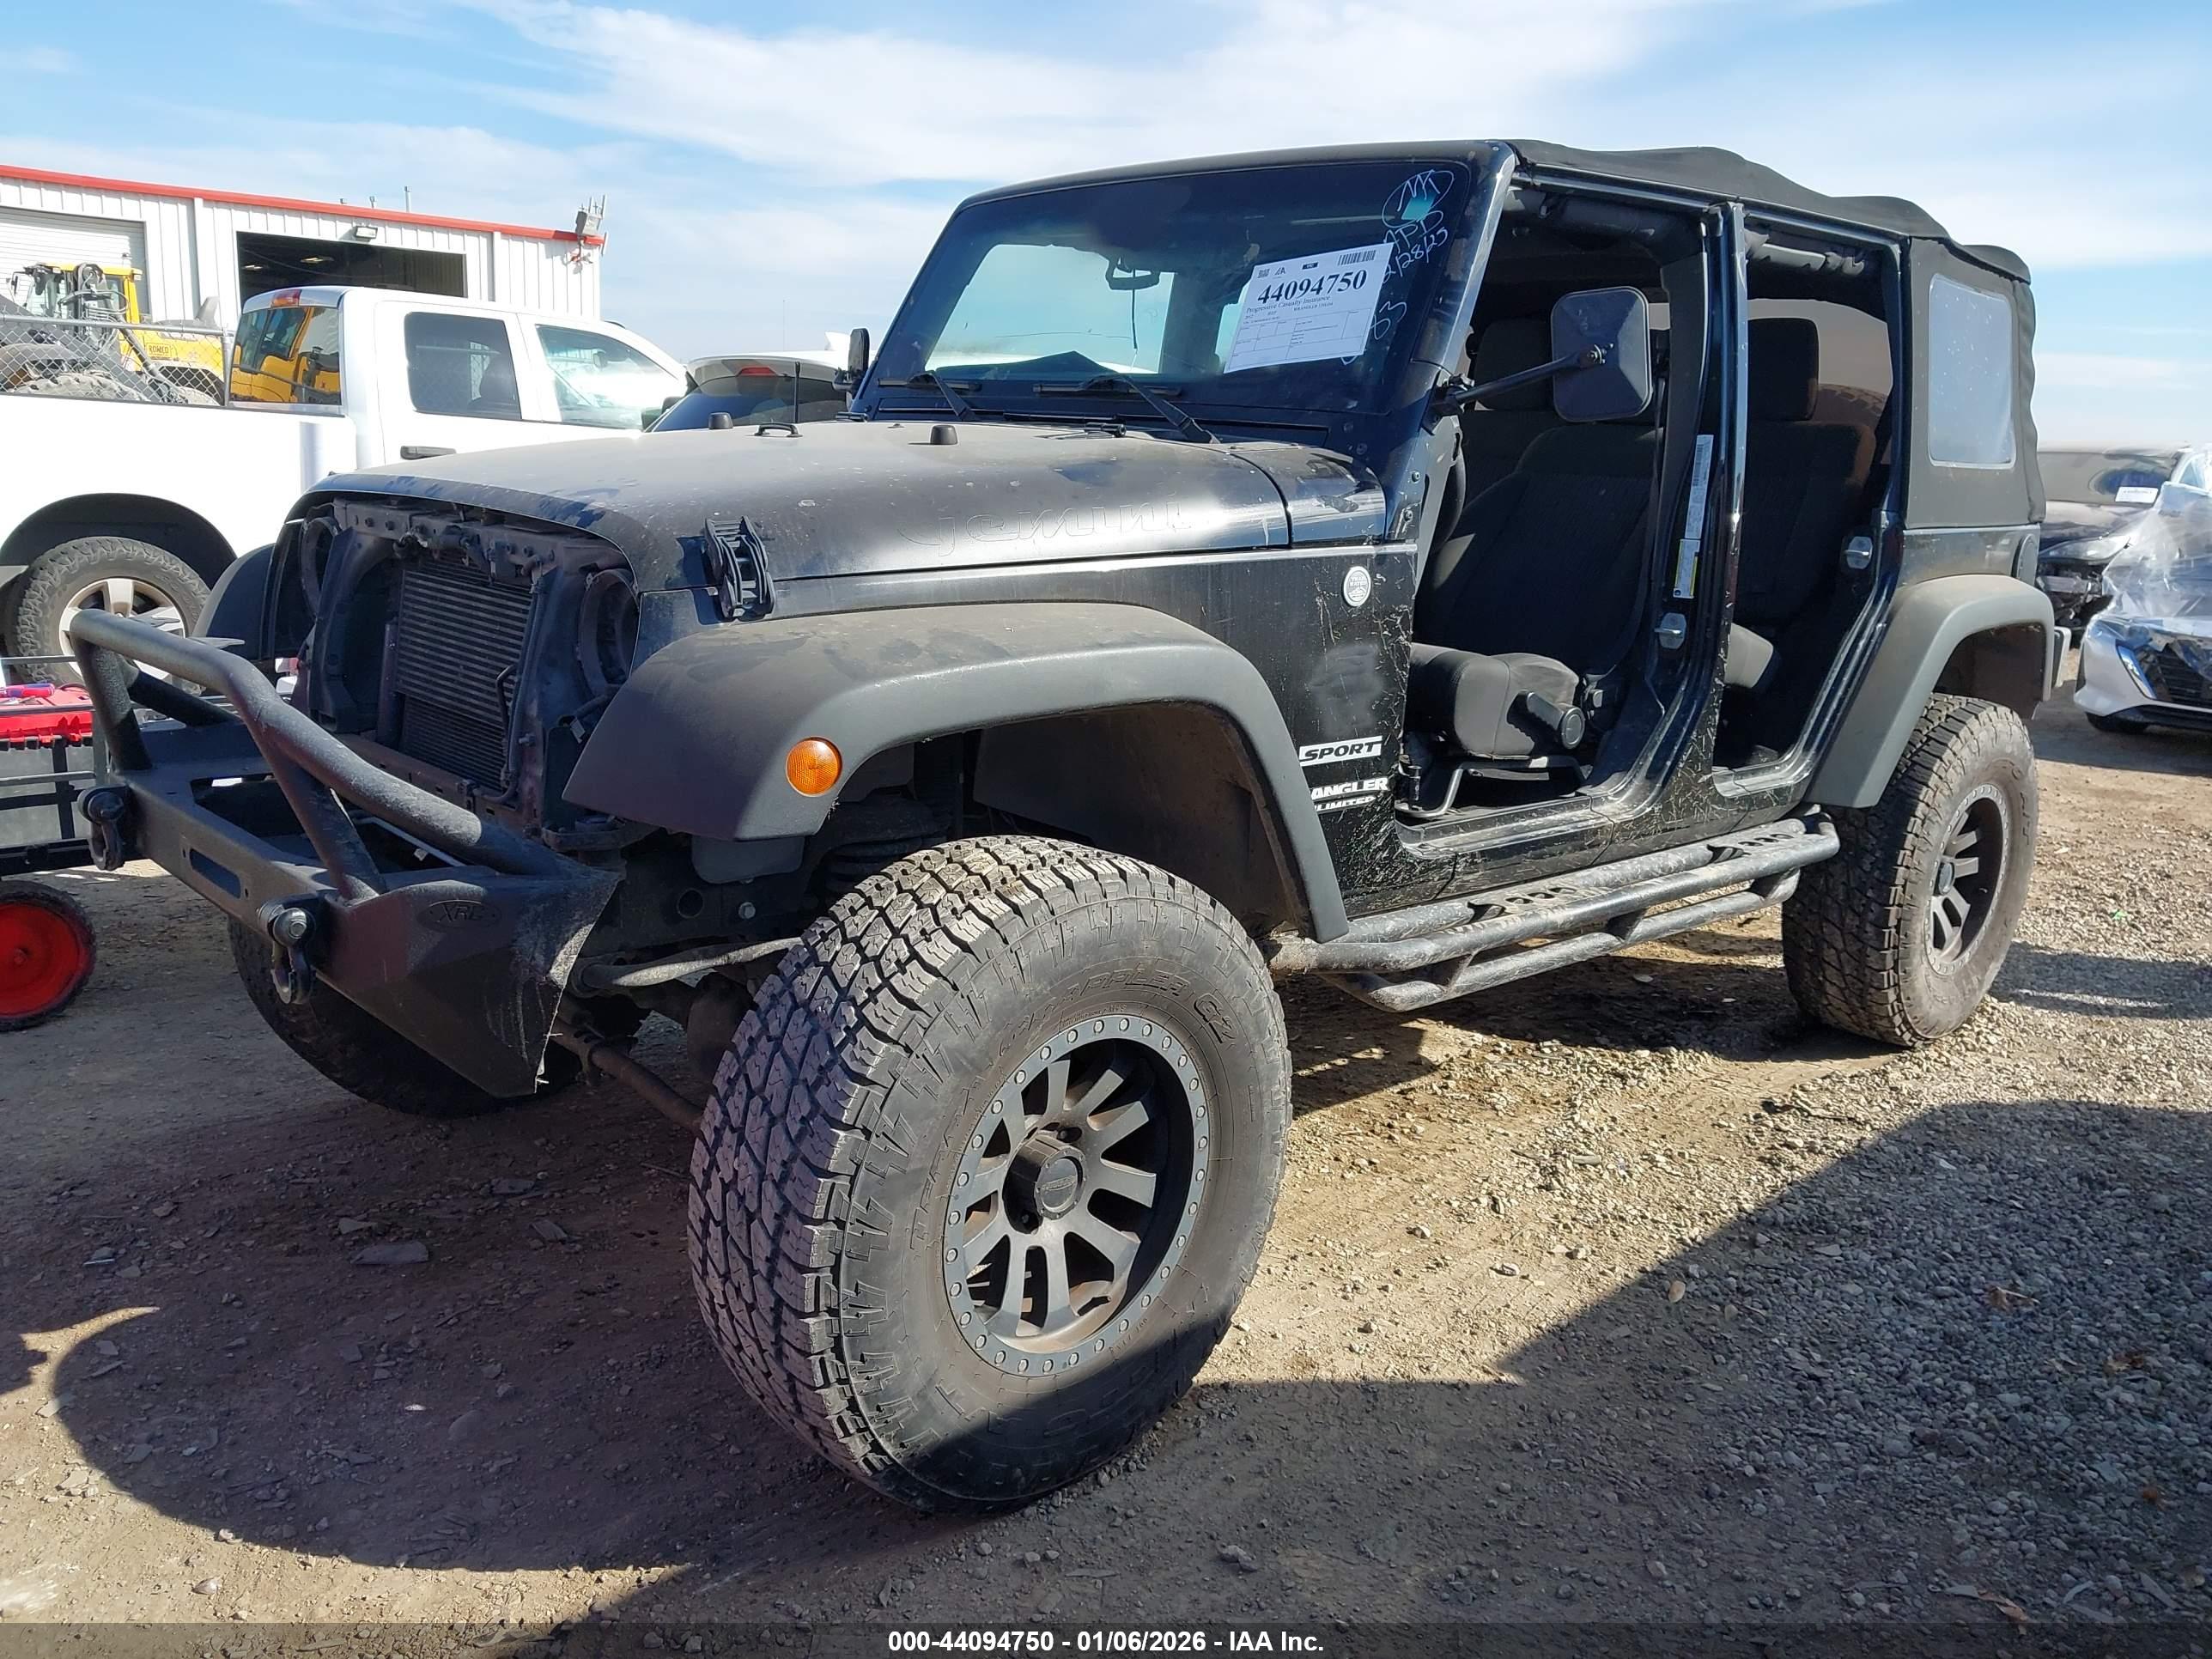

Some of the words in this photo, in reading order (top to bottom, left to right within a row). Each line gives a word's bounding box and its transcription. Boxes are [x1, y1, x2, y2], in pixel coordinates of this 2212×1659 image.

[1257, 269, 1367, 304] 44094750
[1246, 303, 1277, 314] Progressive
[1278, 299, 1301, 309] Casualty
[1303, 295, 1330, 304] Insurance
[1302, 741, 1380, 763] SPORT
[1310, 777, 1389, 799] ANGLER
[1314, 795, 1376, 811] LIMITED
